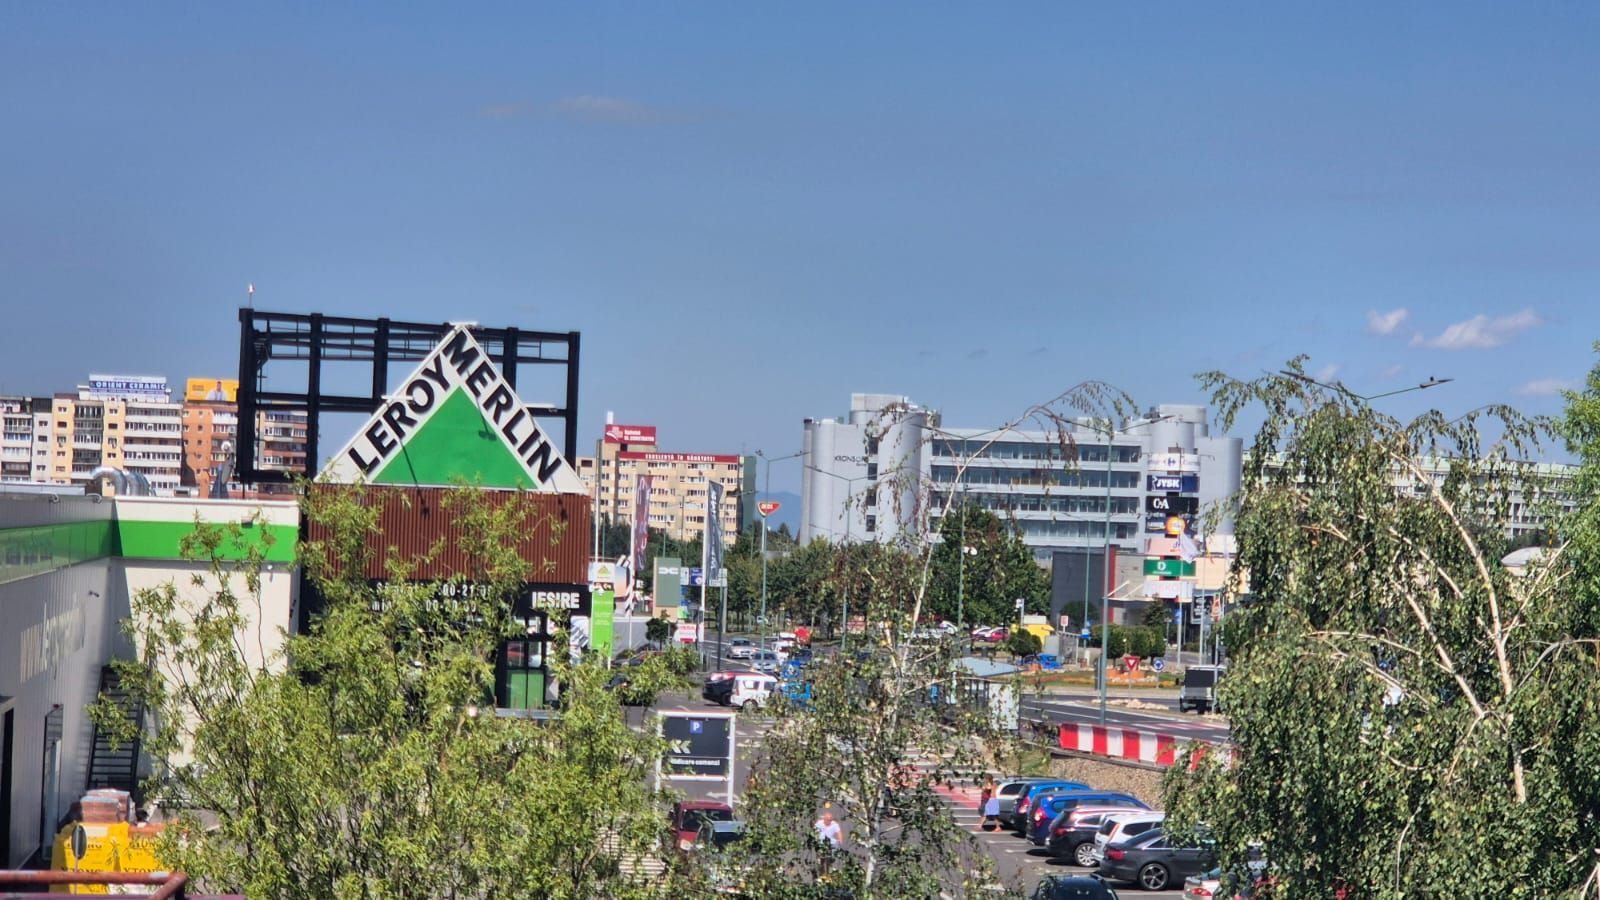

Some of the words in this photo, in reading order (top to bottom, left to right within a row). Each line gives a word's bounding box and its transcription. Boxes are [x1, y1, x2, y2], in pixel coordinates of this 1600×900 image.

[348, 354, 450, 474] LEROY
[442, 331, 562, 484] MERLIN
[1157, 479, 1180, 488] JYSK
